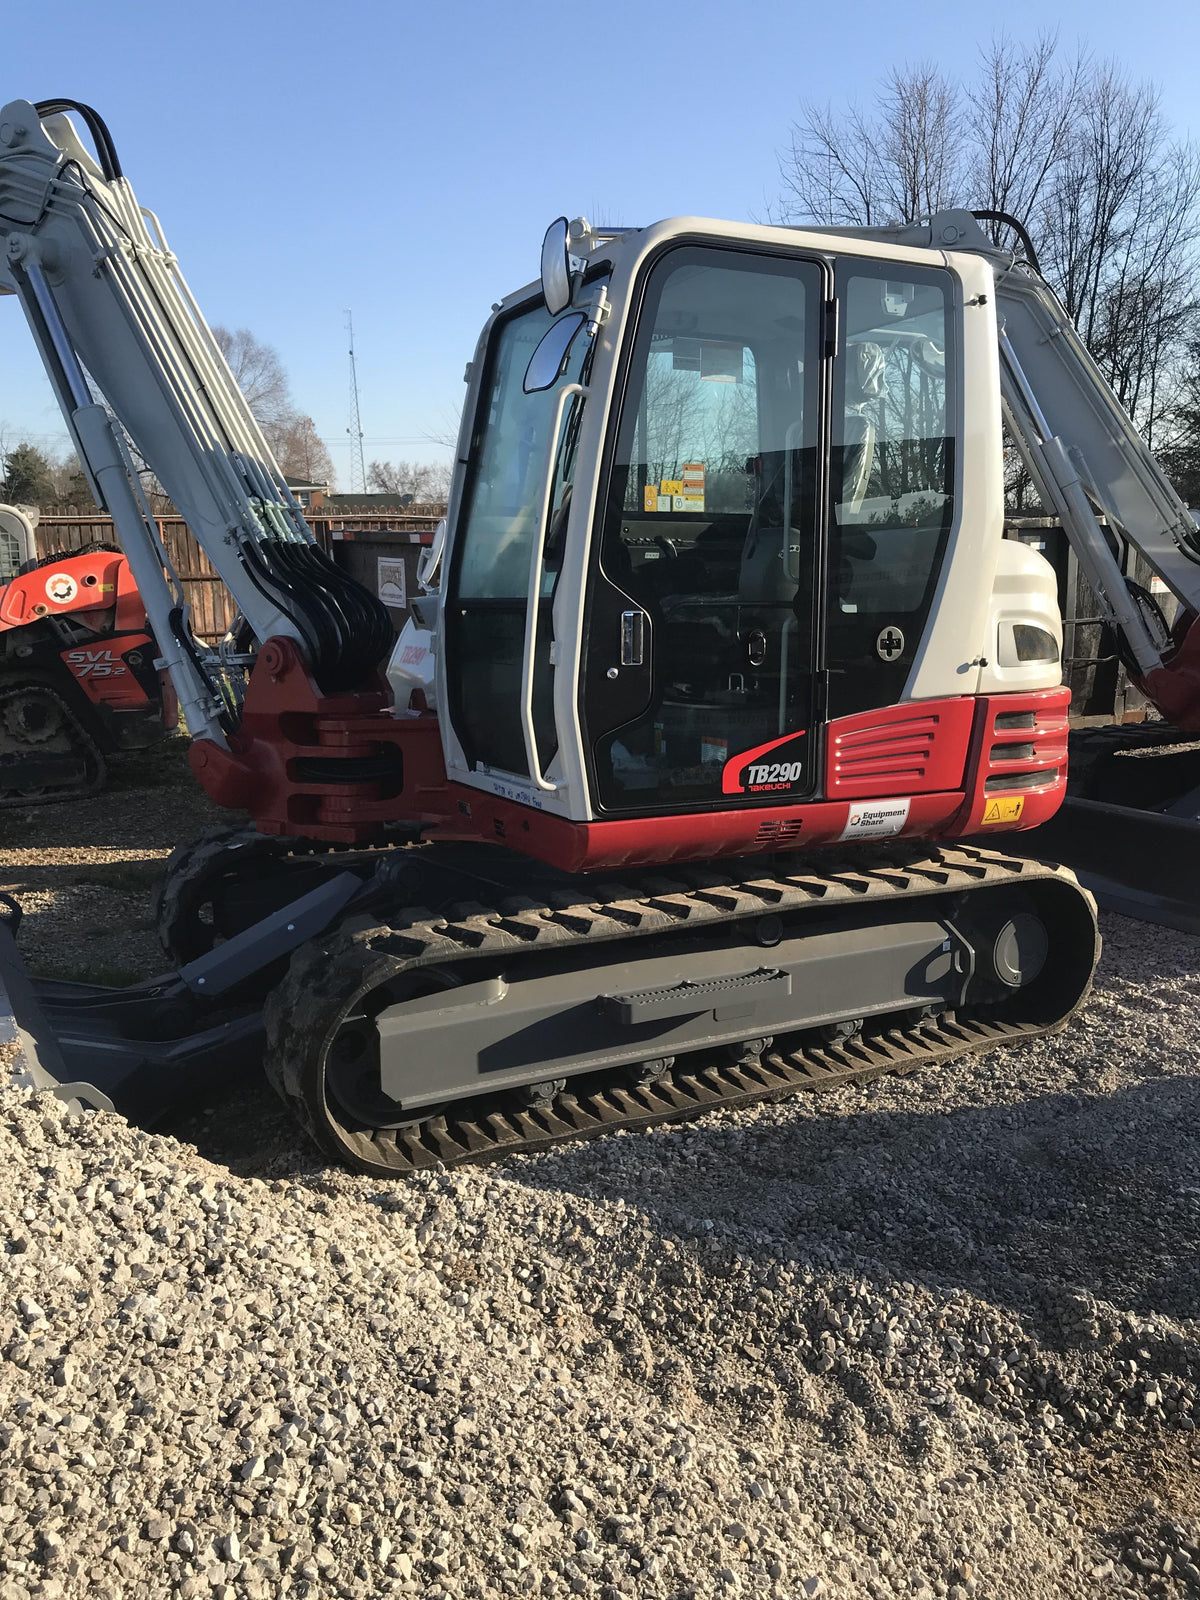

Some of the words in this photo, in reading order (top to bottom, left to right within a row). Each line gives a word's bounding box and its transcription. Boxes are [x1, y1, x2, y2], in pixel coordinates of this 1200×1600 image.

[66, 650, 121, 664] SVL
[748, 761, 802, 785] TB290
[748, 782, 791, 792] TAKEUCHI
[862, 809, 906, 819] Equipment
[860, 819, 884, 827] Share
